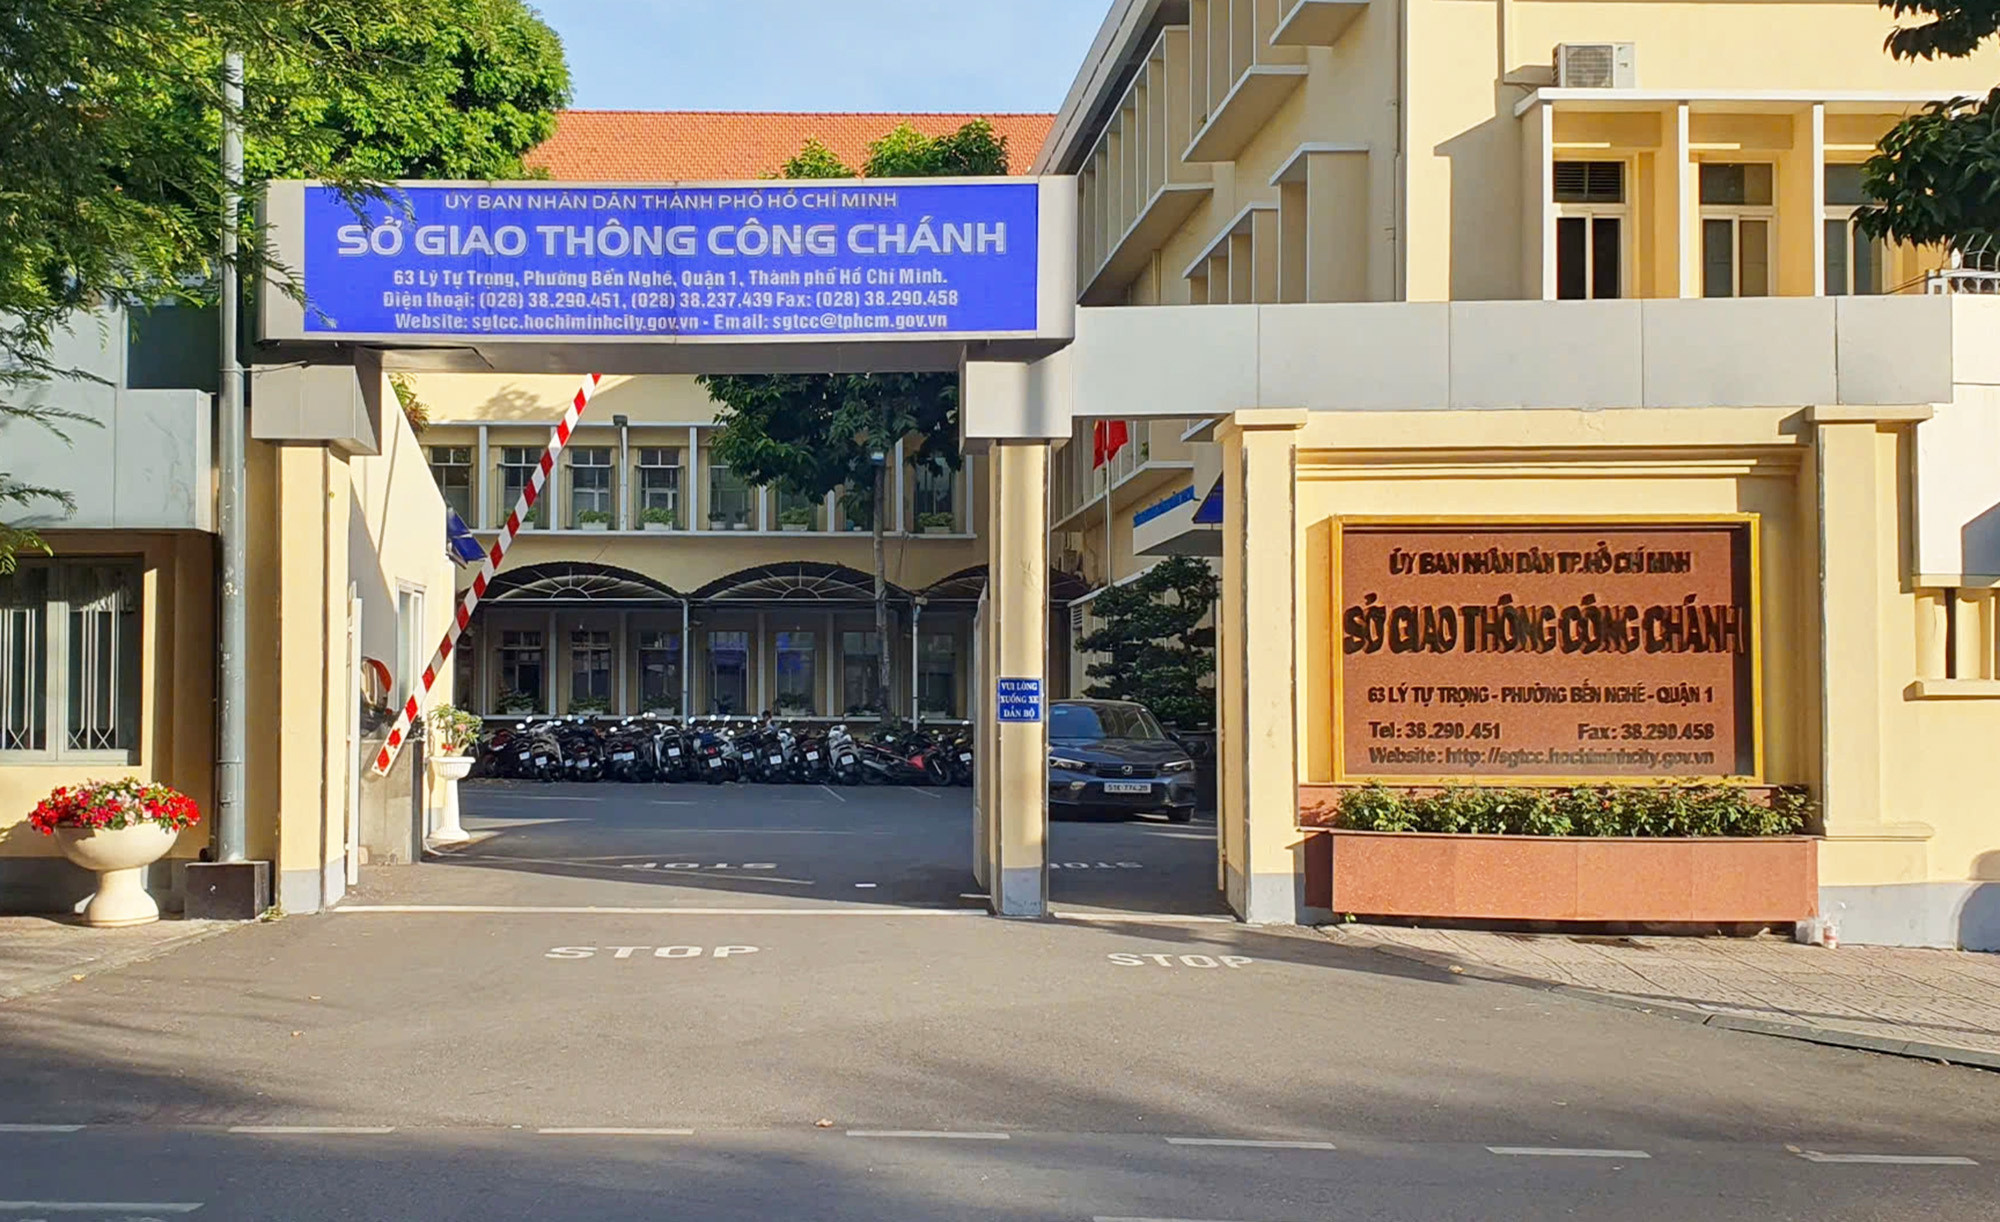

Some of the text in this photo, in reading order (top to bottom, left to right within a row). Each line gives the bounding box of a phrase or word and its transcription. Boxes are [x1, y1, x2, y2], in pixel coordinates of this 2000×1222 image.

[478, 194, 522, 209] BAN
[528, 191, 587, 209] NHÂN
[592, 191, 637, 209] DÂN
[642, 191, 712, 209] THÀNH
[718, 188, 764, 209] PHỐ
[768, 187, 798, 208] HỒ
[802, 190, 837, 208] CHÍ
[842, 193, 897, 208] MINH
[337, 215, 1006, 256] SỞ GIAO THÔNG CÔNG CHÁNH
[394, 270, 415, 285] 63
[420, 270, 438, 287] Lý
[442, 270, 463, 290] Tự
[467, 270, 520, 289] Trọng,
[524, 270, 588, 288] Phường
[592, 268, 624, 286] Bến
[681, 270, 725, 290] Quận
[804, 266, 837, 287] phố
[840, 266, 861, 285] Hồ
[867, 268, 895, 284] Chí
[900, 268, 948, 284] Minh.
[383, 290, 958, 311] Điện thoại: (028) 38.290.451, (028) 38.237.439 Fax: (028) 38.290.458
[395, 313, 468, 329] Website:
[714, 313, 768, 329] Email:
[773, 312, 947, 331] sgtcc@tphcm.gov.vn
[1418, 552, 1459, 574] BAN
[1462, 547, 1513, 574] NHÂN
[1516, 546, 1554, 574] DÂN
[1614, 546, 1645, 574] CHÍ
[1647, 552, 1691, 574] MINH
[1343, 592, 1744, 654] SỞ GIAO THÔNG CÔNG CHÁNH
[1001, 682, 1015, 691] VUI
[1368, 686, 1385, 703] 63
[1388, 682, 1408, 703] LÝ
[1411, 686, 1434, 707] TỰ
[1437, 686, 1489, 707] TRỌNG
[1501, 682, 1567, 703] PHƯỜNG
[1570, 679, 1600, 703] BẾN
[1604, 682, 1646, 703] NGHÉ
[1656, 682, 1700, 706] QUẬN
[1704, 686, 1713, 703] 1
[1000, 692, 1027, 704] XUỐNG
[1369, 722, 1714, 740] Tel: 38.290.451 Fax: 38.290.458
[544, 946, 761, 959] STOP
[1107, 952, 1253, 969] STOP
